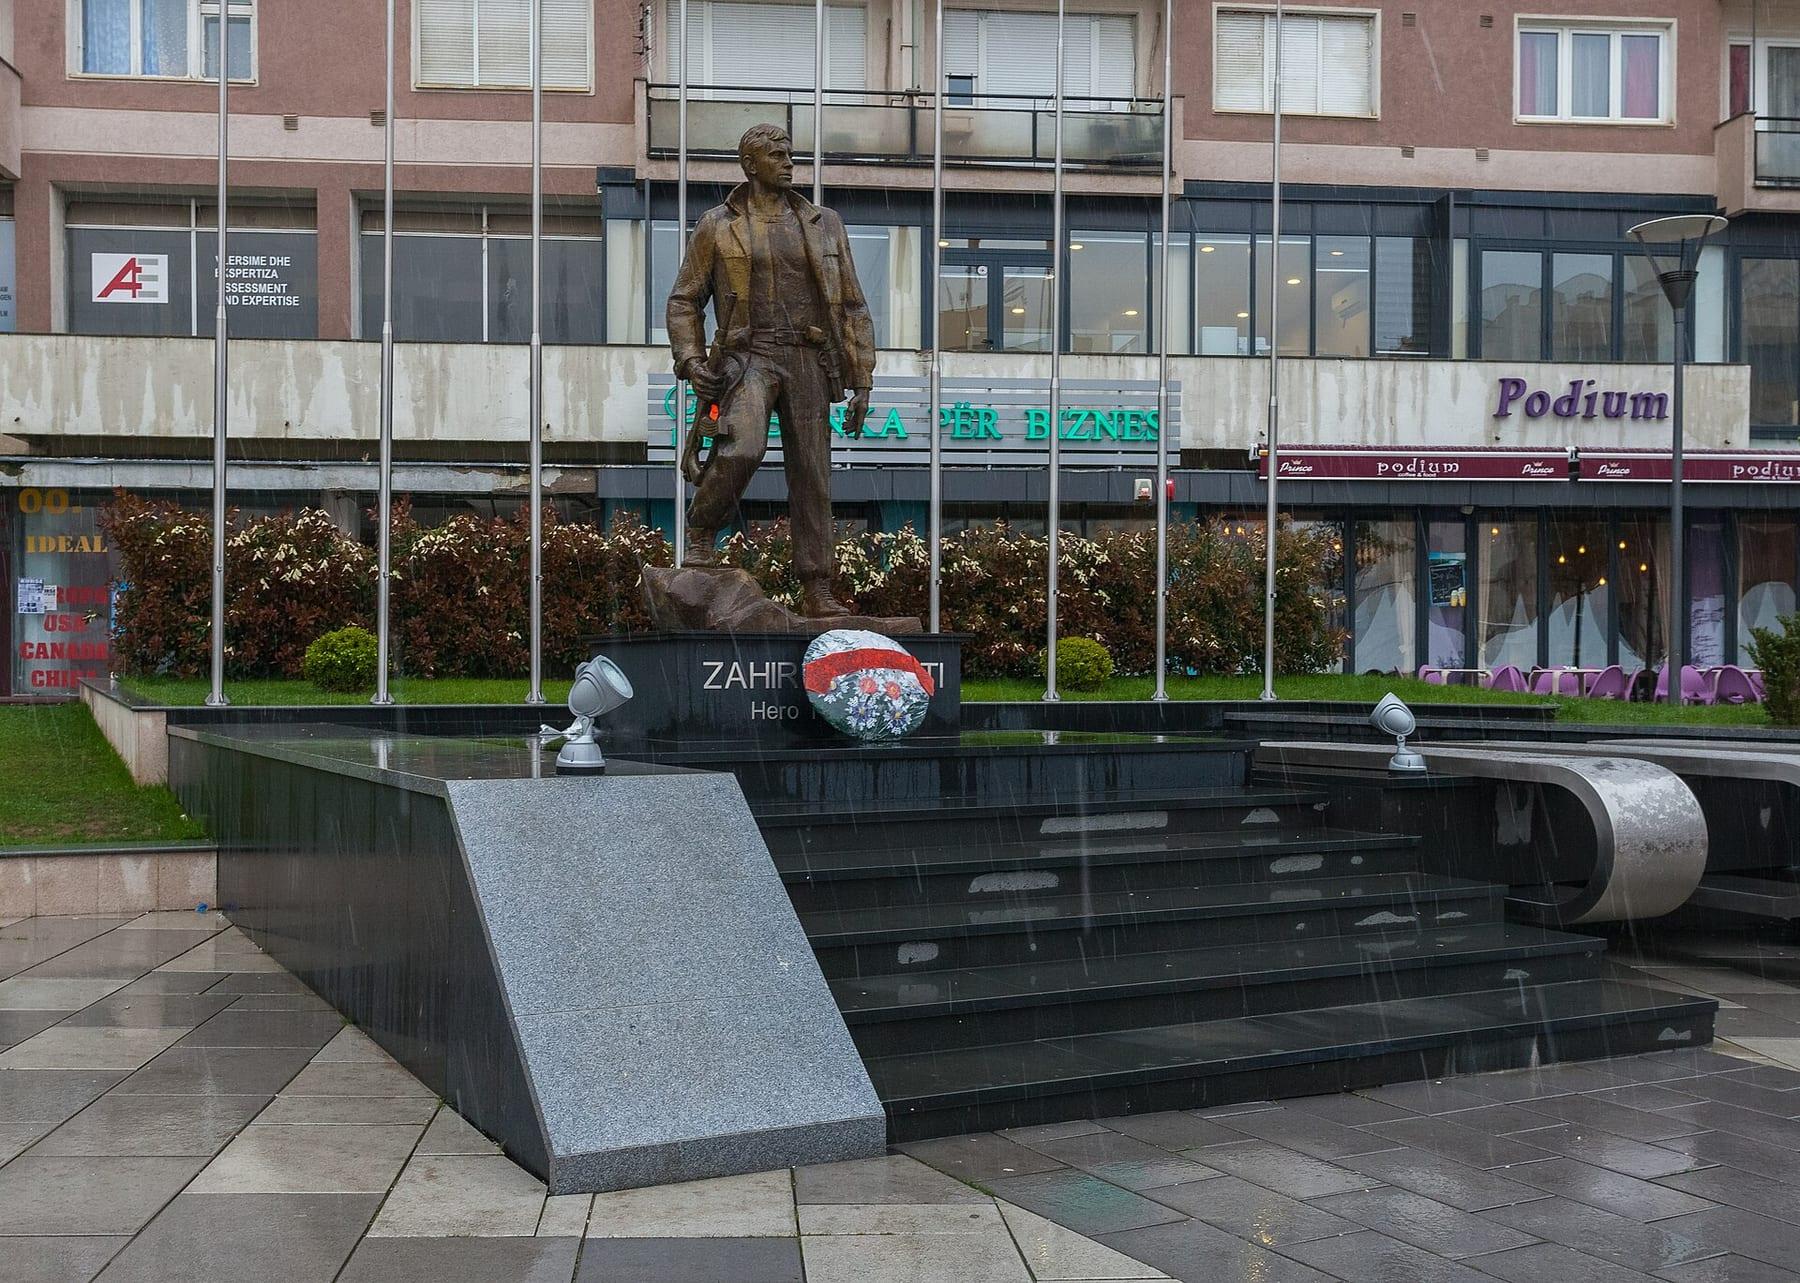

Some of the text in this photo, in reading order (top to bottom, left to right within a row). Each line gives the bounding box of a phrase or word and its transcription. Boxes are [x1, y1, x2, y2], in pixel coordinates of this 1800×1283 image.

[269, 256, 291, 266] DHE
[217, 282, 288, 294] SSESSMENT
[242, 296, 300, 306] EXPERTISE
[1493, 378, 1668, 418] Podium
[1376, 458, 1459, 476] podium
[1733, 461, 1800, 479] podiu
[26, 535, 108, 553] IDEAL
[19, 642, 108, 660] CANADA
[702, 661, 799, 689] ZAHIR
[751, 701, 799, 720] Hero
